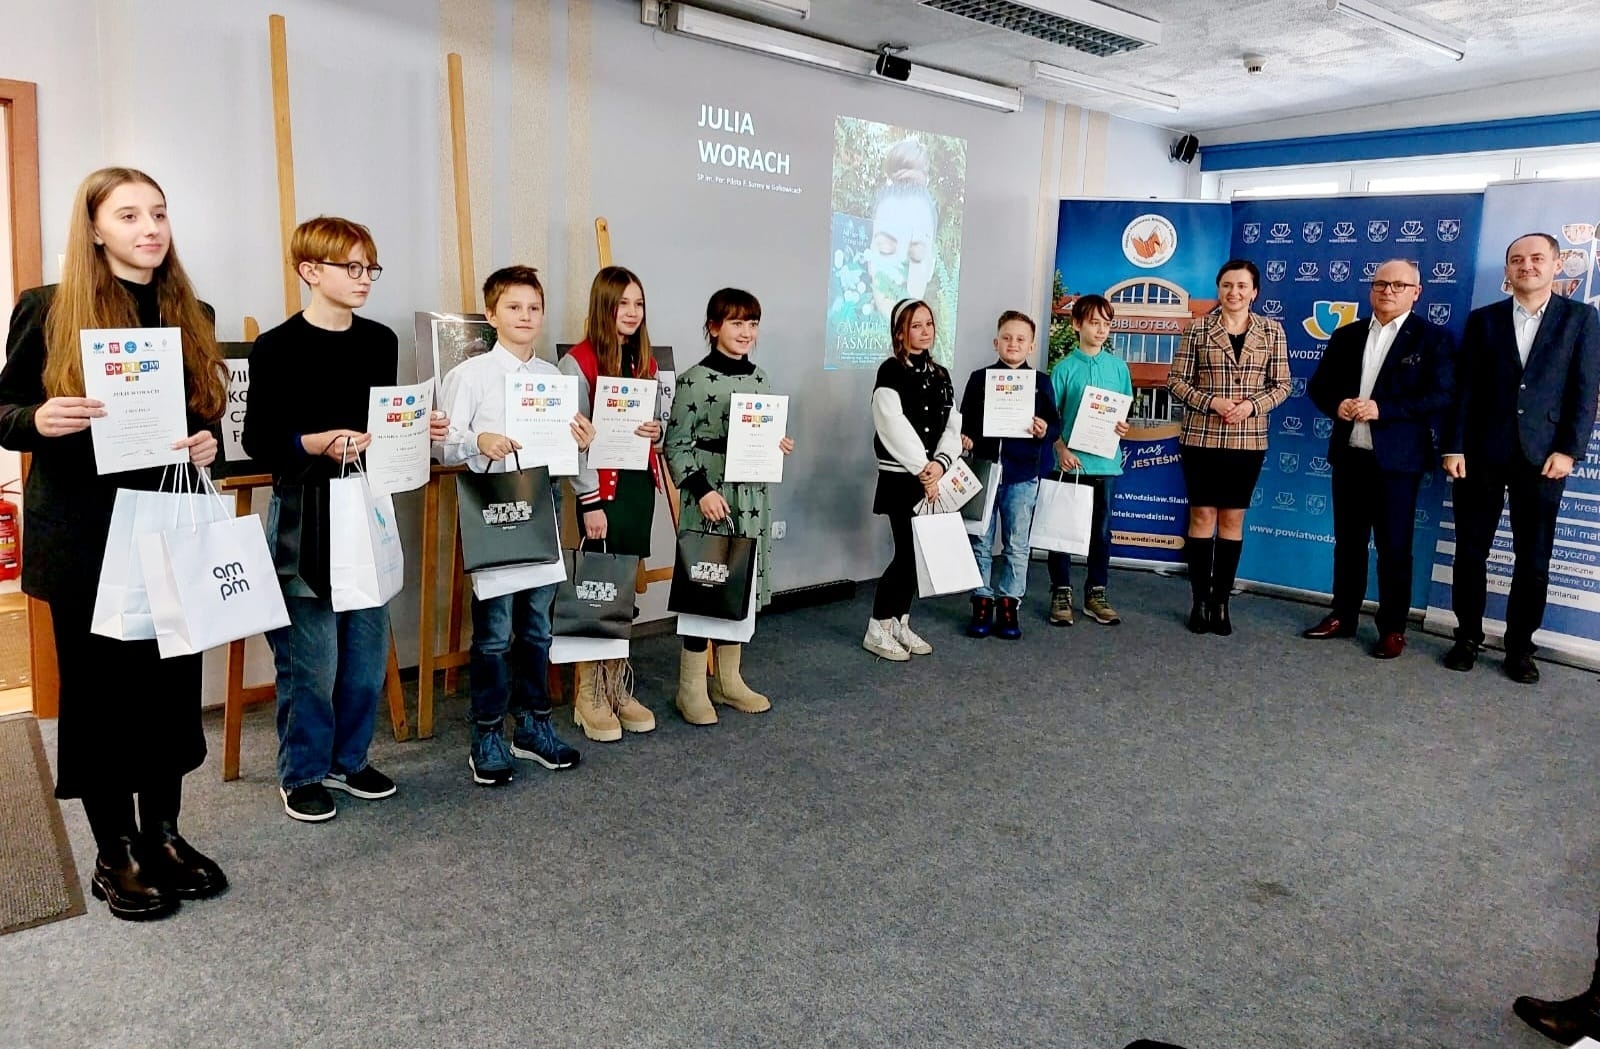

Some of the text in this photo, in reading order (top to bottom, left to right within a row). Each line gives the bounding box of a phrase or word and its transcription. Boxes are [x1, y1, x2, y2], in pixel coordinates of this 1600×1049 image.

[698, 104, 755, 136] JULIA
[698, 139, 790, 175] WORACH
[1111, 319, 1180, 331] BIBLIOTEKA
[1316, 343, 1328, 351] PO
[1137, 444, 1164, 456] nas
[1131, 454, 1182, 469] JESTEŚM
[488, 500, 532, 514] STAR
[482, 509, 531, 524] WARS
[1249, 523, 1337, 544] www.powiatwodz
